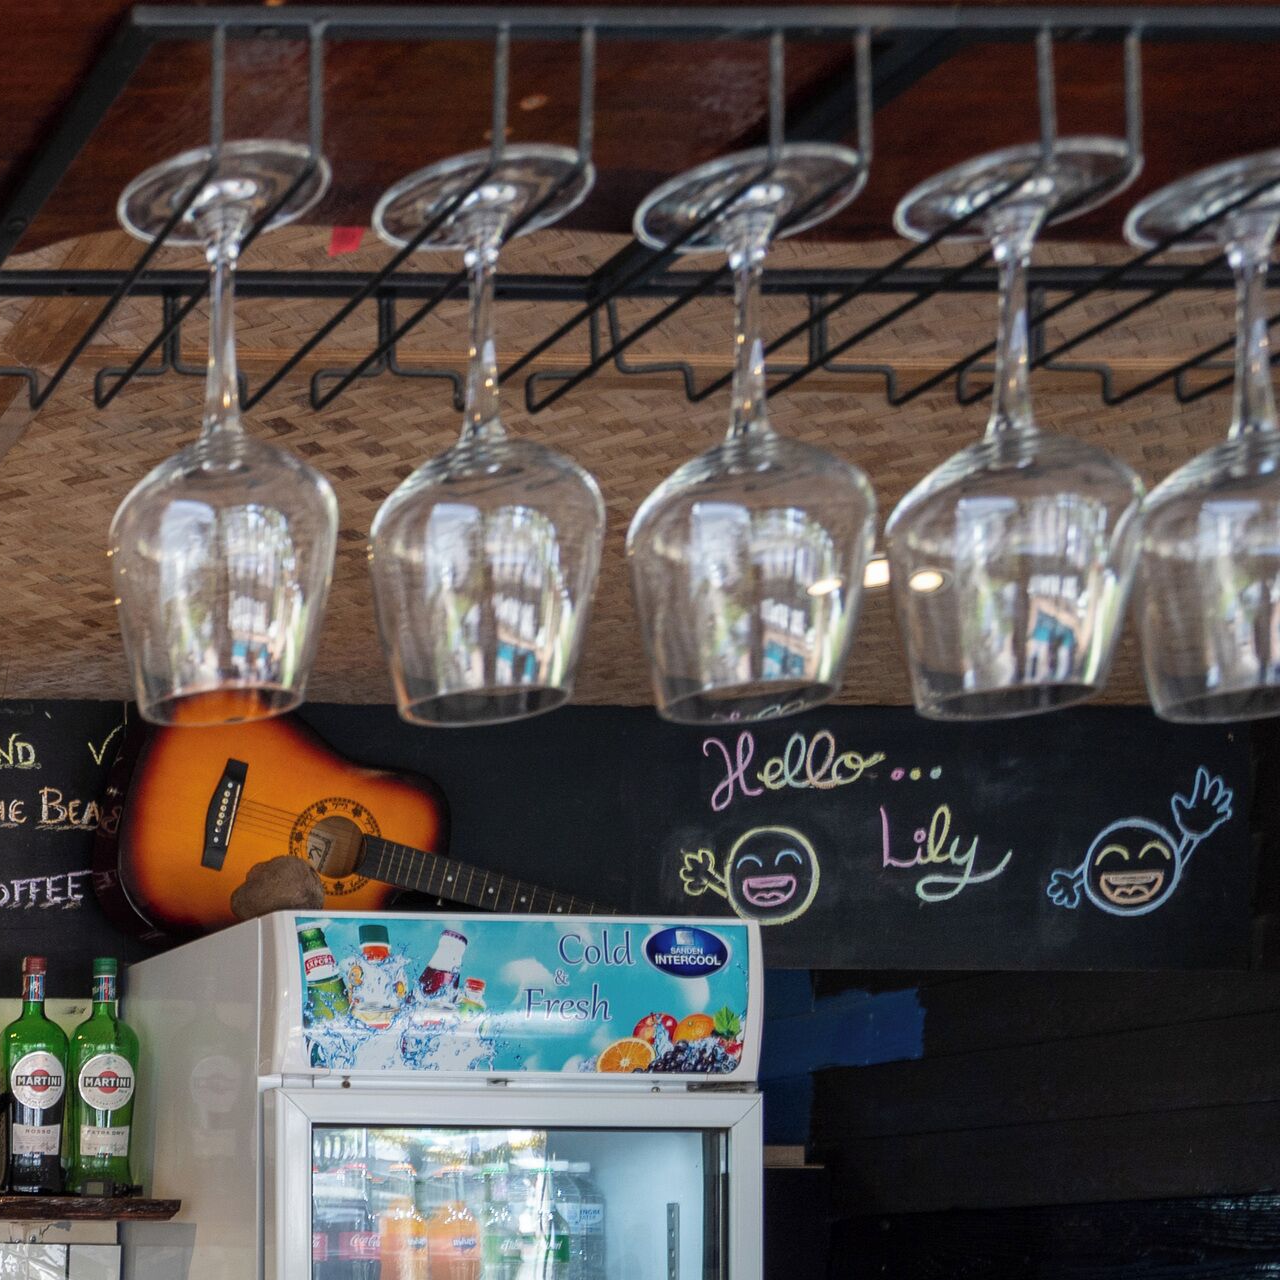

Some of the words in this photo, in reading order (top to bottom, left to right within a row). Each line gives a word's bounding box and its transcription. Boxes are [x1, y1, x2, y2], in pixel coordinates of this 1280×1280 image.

[880, 804, 1013, 902] Lily
[558, 928, 635, 967] Cold
[670, 946, 704, 956] SANDEN
[655, 954, 723, 967] INTERCOOL
[554, 968, 570, 986] &
[523, 983, 612, 1023] Fresh
[16, 1076, 61, 1087] MARTINI
[84, 1077, 131, 1088] MARTINI
